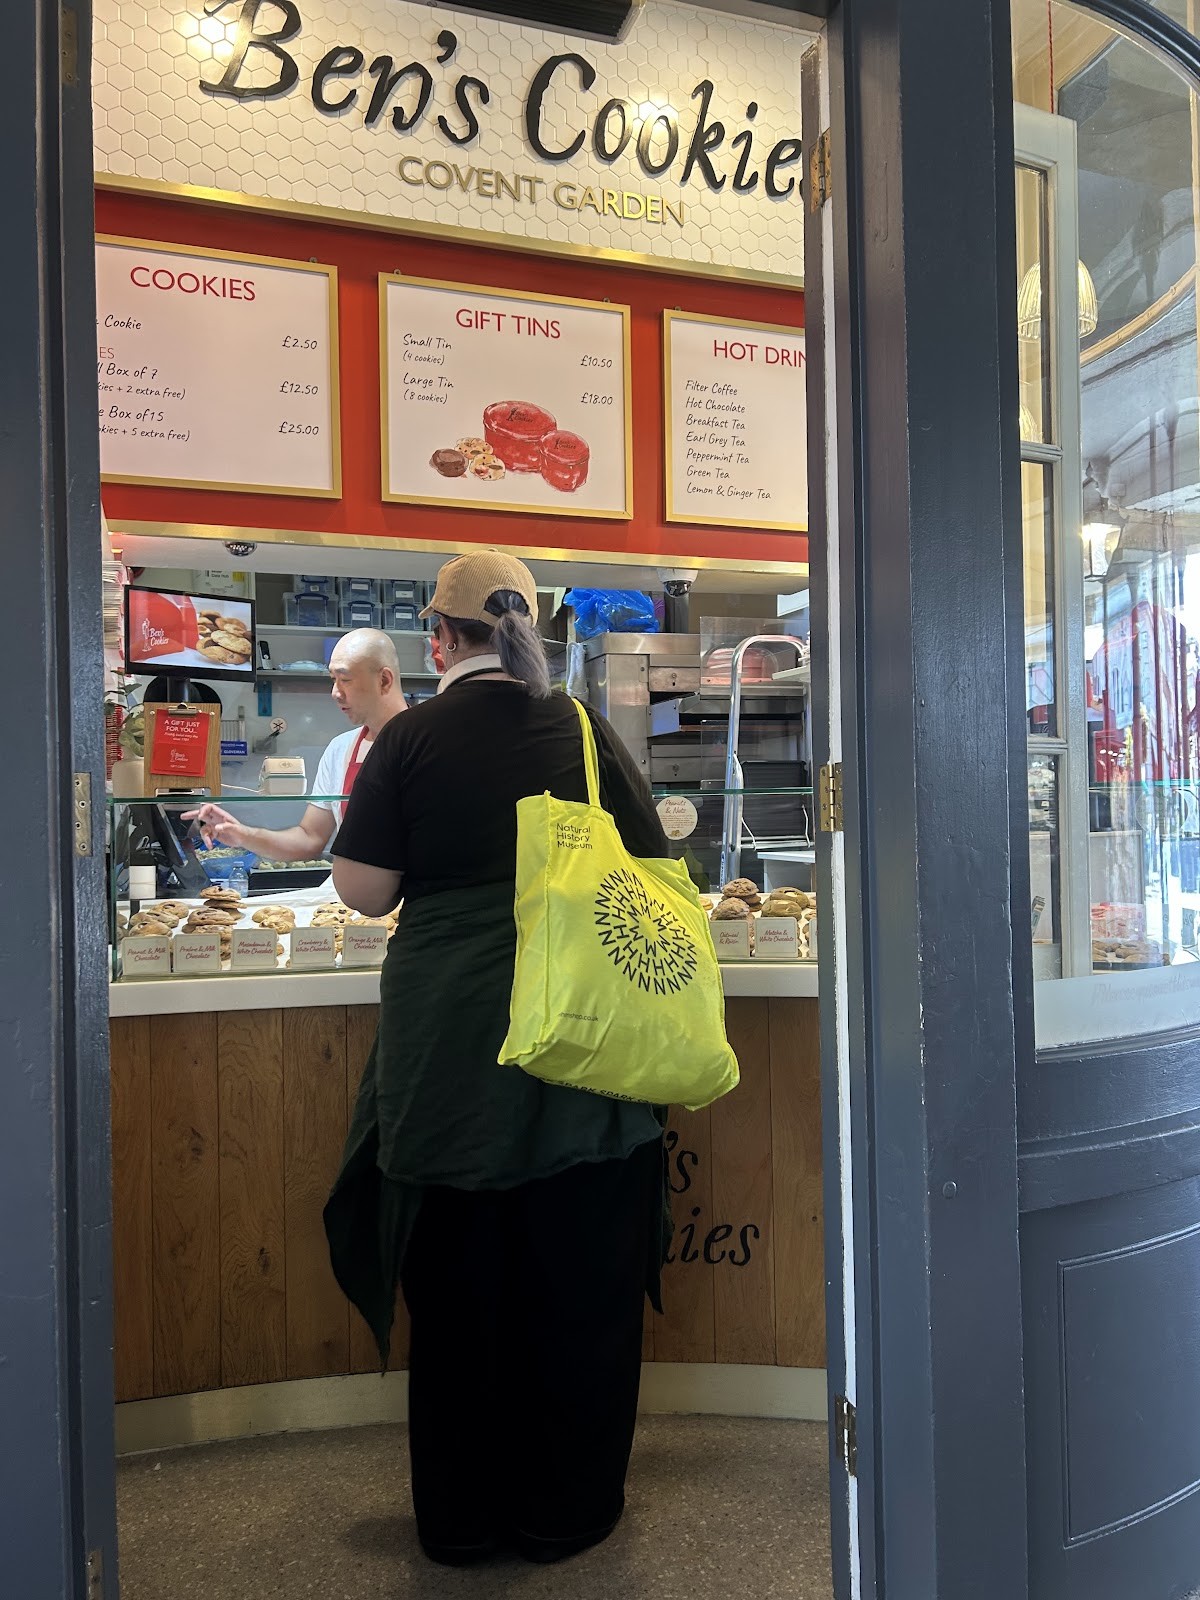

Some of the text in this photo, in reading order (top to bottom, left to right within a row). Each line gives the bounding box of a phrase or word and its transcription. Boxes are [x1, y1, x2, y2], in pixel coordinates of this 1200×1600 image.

[199, 0, 804, 198] Ben's Cookie
[398, 157, 684, 227] COVENT GARDEN
[130, 266, 256, 301] COOKIES
[104, 314, 142, 330] Cookie
[455, 308, 561, 339] GIFT TINS
[281, 335, 318, 350] £2.50
[403, 333, 452, 350] Small Tin
[402, 351, 445, 366] (4 cookies)
[713, 340, 758, 362] HOT
[580, 354, 613, 368] £10.50
[106, 362, 130, 377] Box
[133, 366, 148, 379] of
[151, 369, 158, 380] 7
[279, 380, 319, 395] £12.50
[403, 372, 454, 388] Large Tin
[685, 380, 738, 396] Filter Coffee
[126, 385, 133, 393] 2
[135, 386, 160, 396] extra
[162, 388, 186, 400] free)
[403, 388, 448, 405] (8 cookies)
[580, 394, 613, 405] £18.00
[108, 405, 132, 419] Box
[685, 396, 746, 414] Hot Chocolate
[278, 421, 320, 436] £25.00
[686, 414, 746, 430] Breakfast Tea
[131, 428, 138, 436] 5
[140, 429, 166, 438] extra
[167, 429, 191, 442] free)
[686, 432, 746, 448] Earl Grey Tea
[686, 448, 750, 464] Peppermint Tea
[686, 465, 730, 479] Green Tea
[686, 482, 772, 500] Lemon & Ginger Tea
[150, 628, 165, 638] Ben's
[556, 822, 591, 834] Natural
[556, 832, 590, 842] History
[557, 840, 593, 850] Museum
